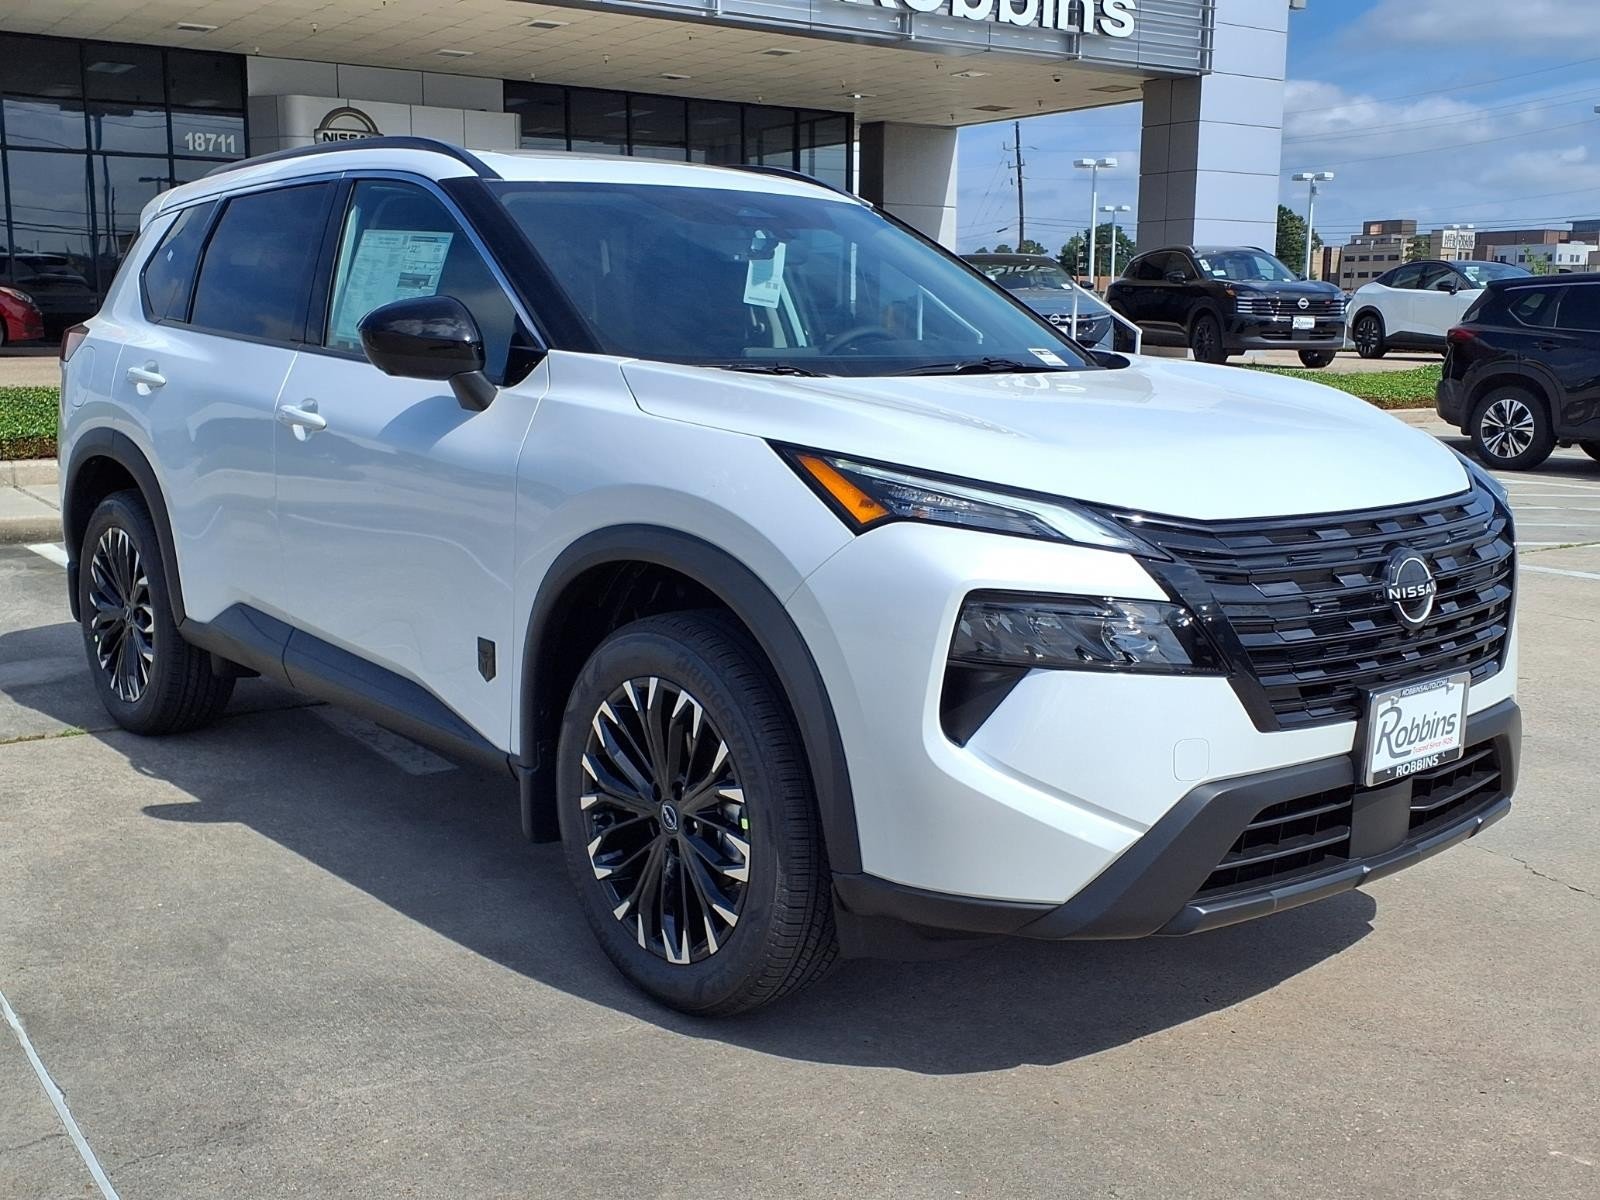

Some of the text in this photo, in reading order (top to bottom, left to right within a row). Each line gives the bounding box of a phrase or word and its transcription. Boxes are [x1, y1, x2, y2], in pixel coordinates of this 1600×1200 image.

[185, 132, 236, 153] 18711
[322, 132, 370, 142] NISS
[1388, 581, 1437, 600] NISSAN
[1376, 706, 1457, 759] Robbins
[1396, 754, 1439, 777] ROBBINS
